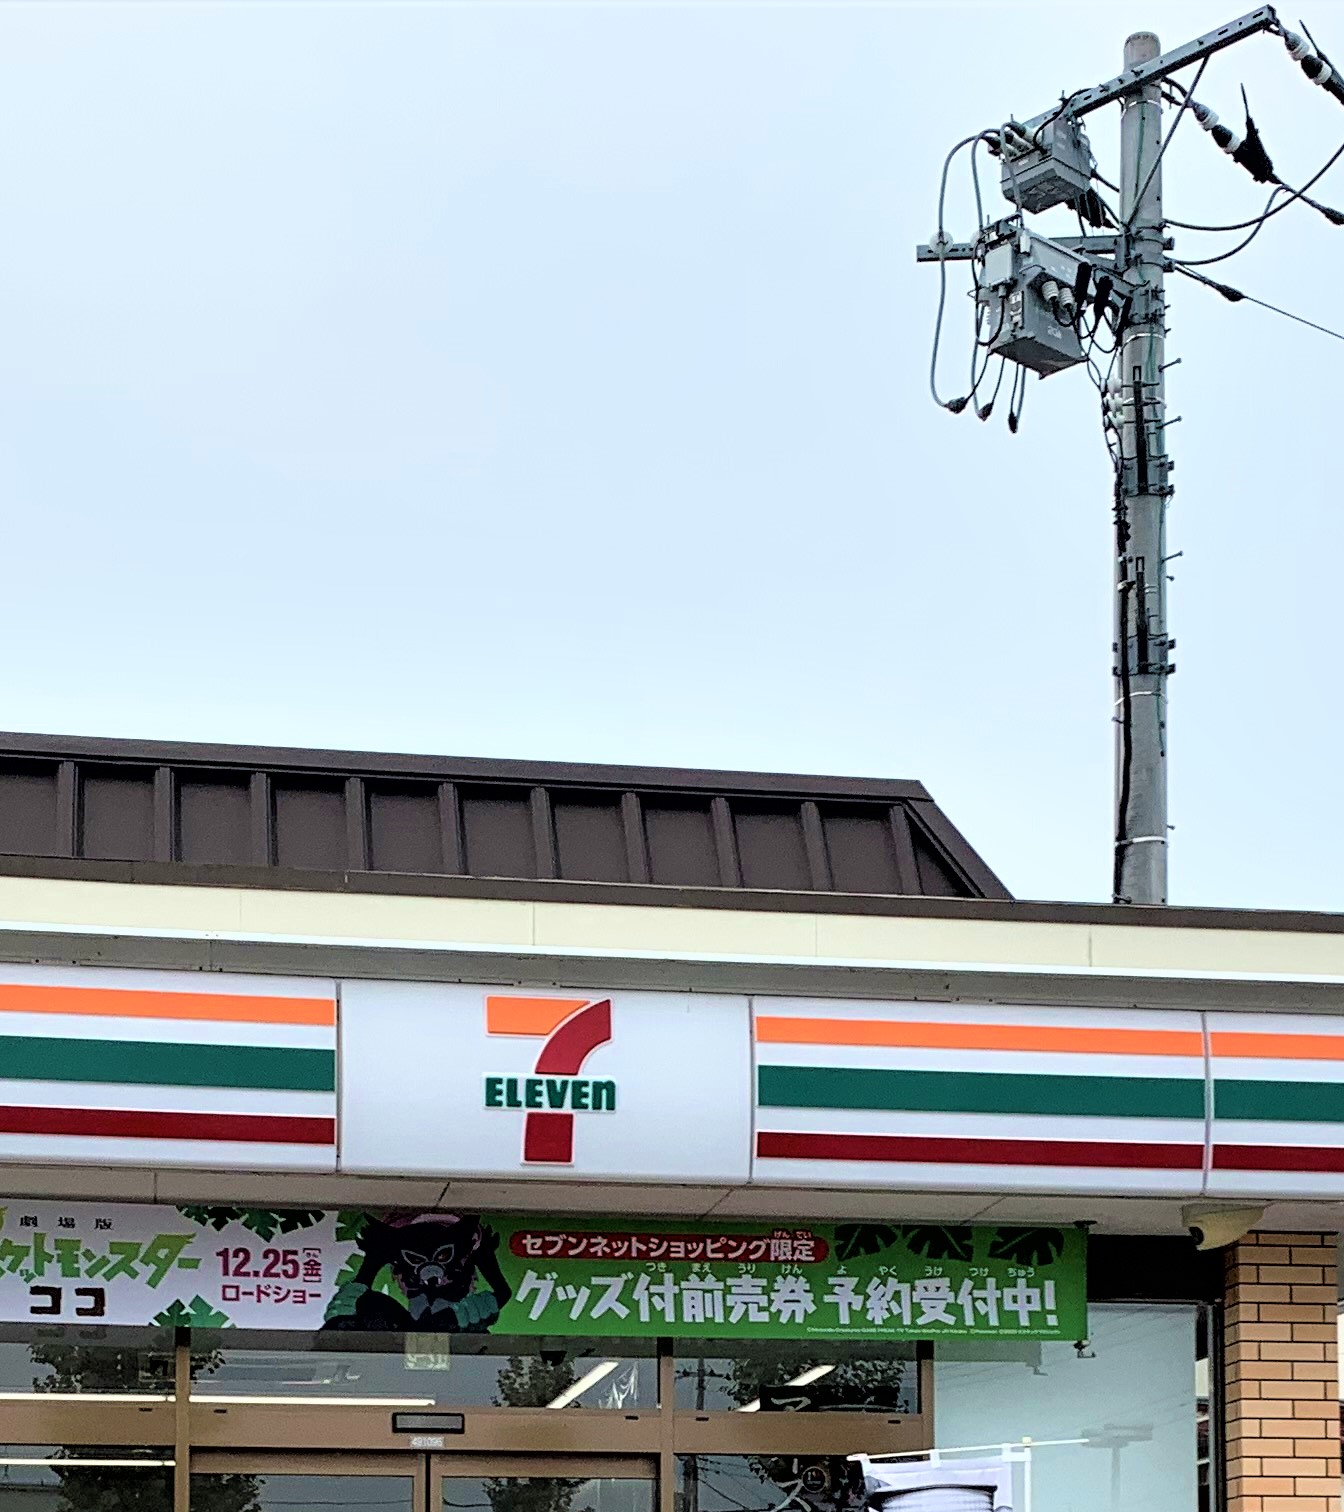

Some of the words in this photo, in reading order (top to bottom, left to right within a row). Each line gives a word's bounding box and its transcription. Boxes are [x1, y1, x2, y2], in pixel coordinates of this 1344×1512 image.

[487, 996, 612, 1162] 7
[19, 1215, 112, 1230] 劇場版
[216, 1247, 300, 1279] 12.25
[521, 1234, 815, 1262] セブンネットショッピング限定
[29, 1285, 105, 1316] ココ
[222, 1284, 321, 1304] ロードショー
[516, 1269, 817, 1324] グッズ付前売券
[823, 1276, 1058, 1327] 予約受付中!
